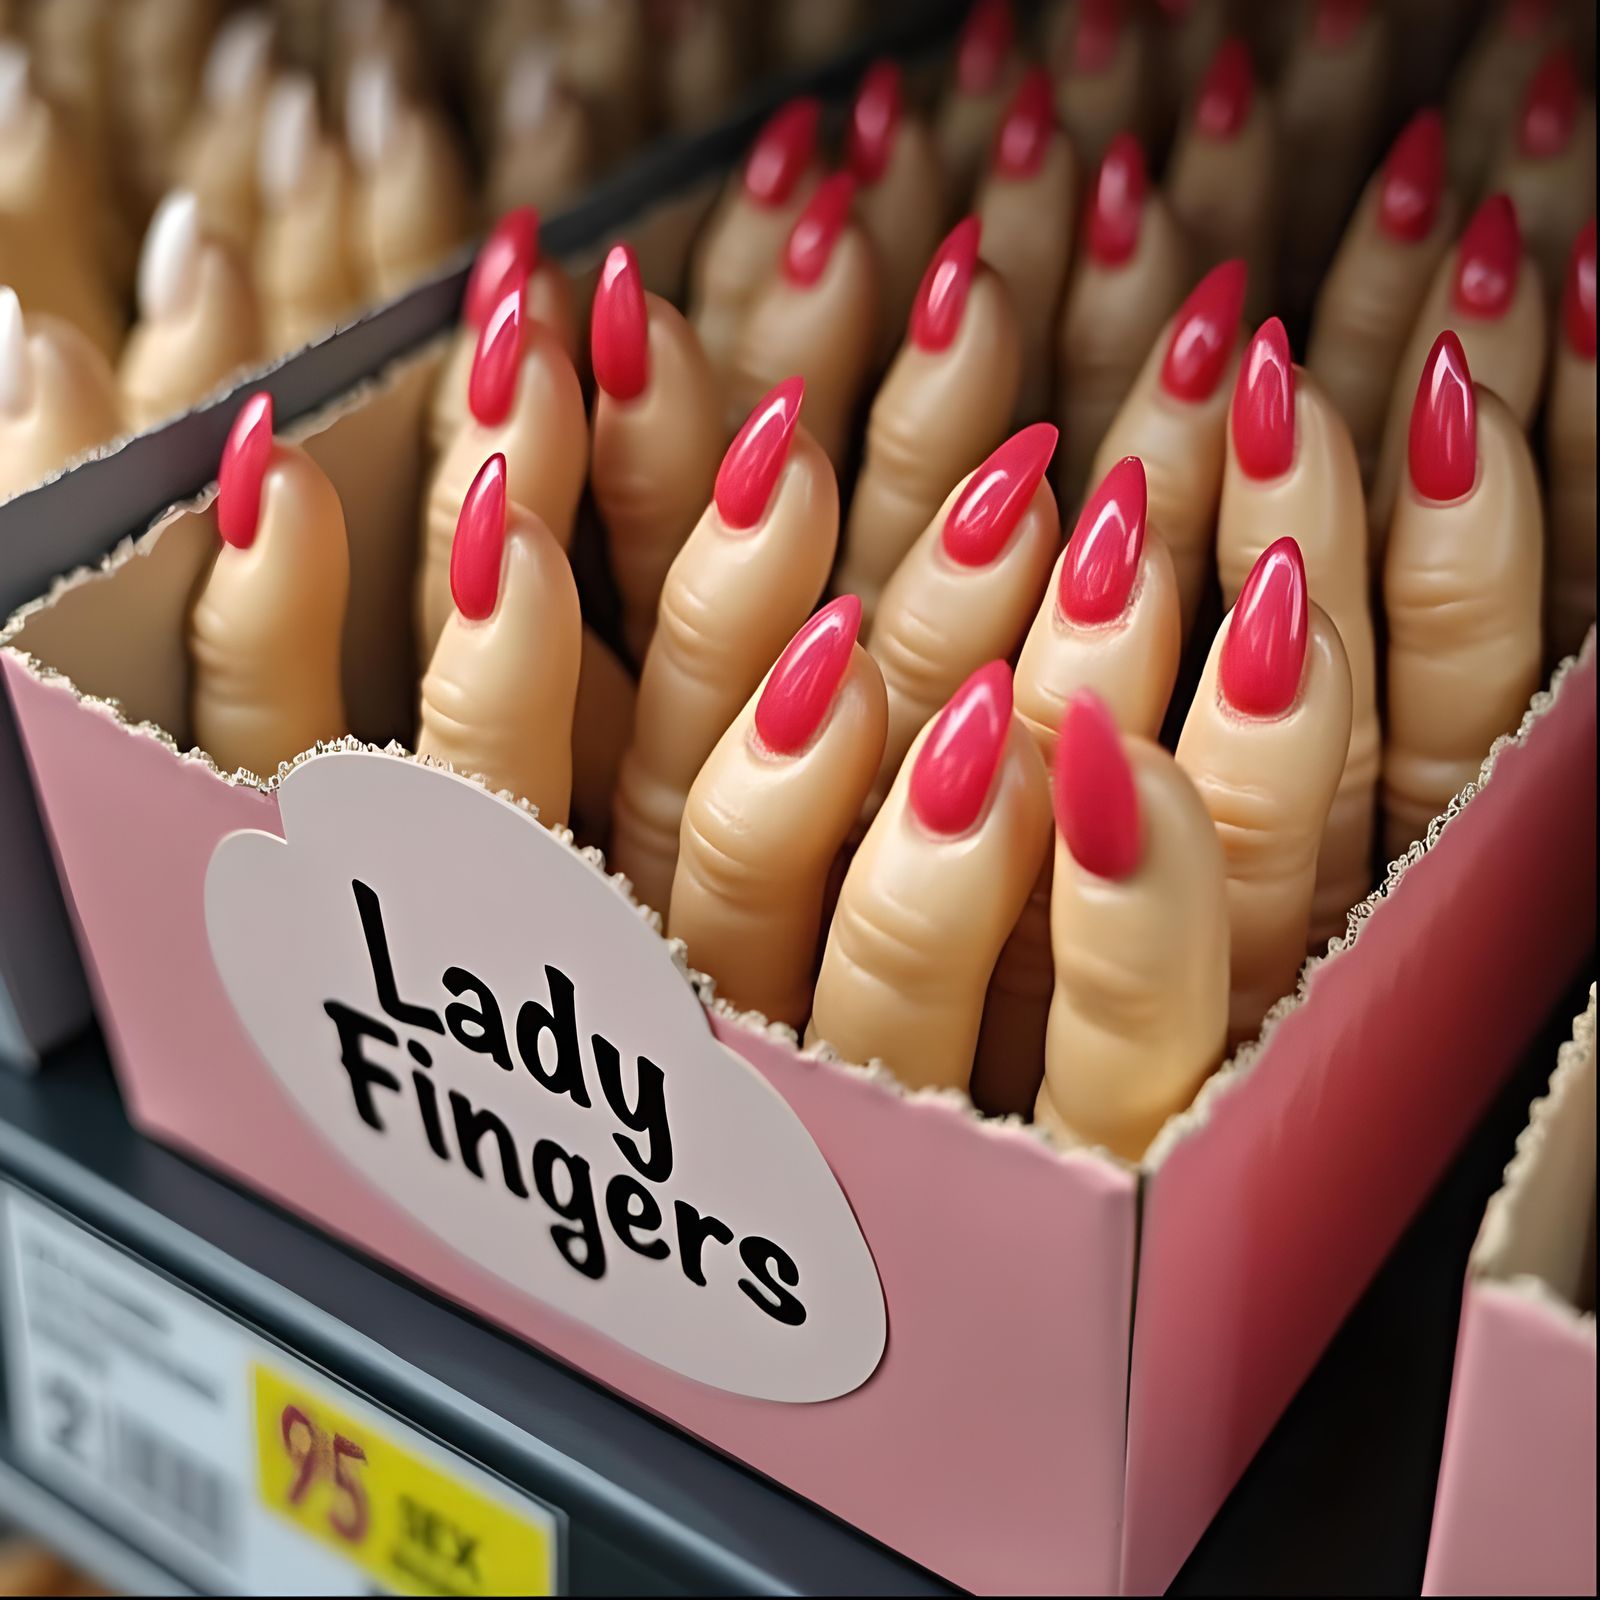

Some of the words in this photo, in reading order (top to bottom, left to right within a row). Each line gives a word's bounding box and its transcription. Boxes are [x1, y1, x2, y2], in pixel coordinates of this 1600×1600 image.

[322, 999, 808, 1327] Fingers
[351, 878, 673, 1184] Lady
[279, 1404, 369, 1544] 95
